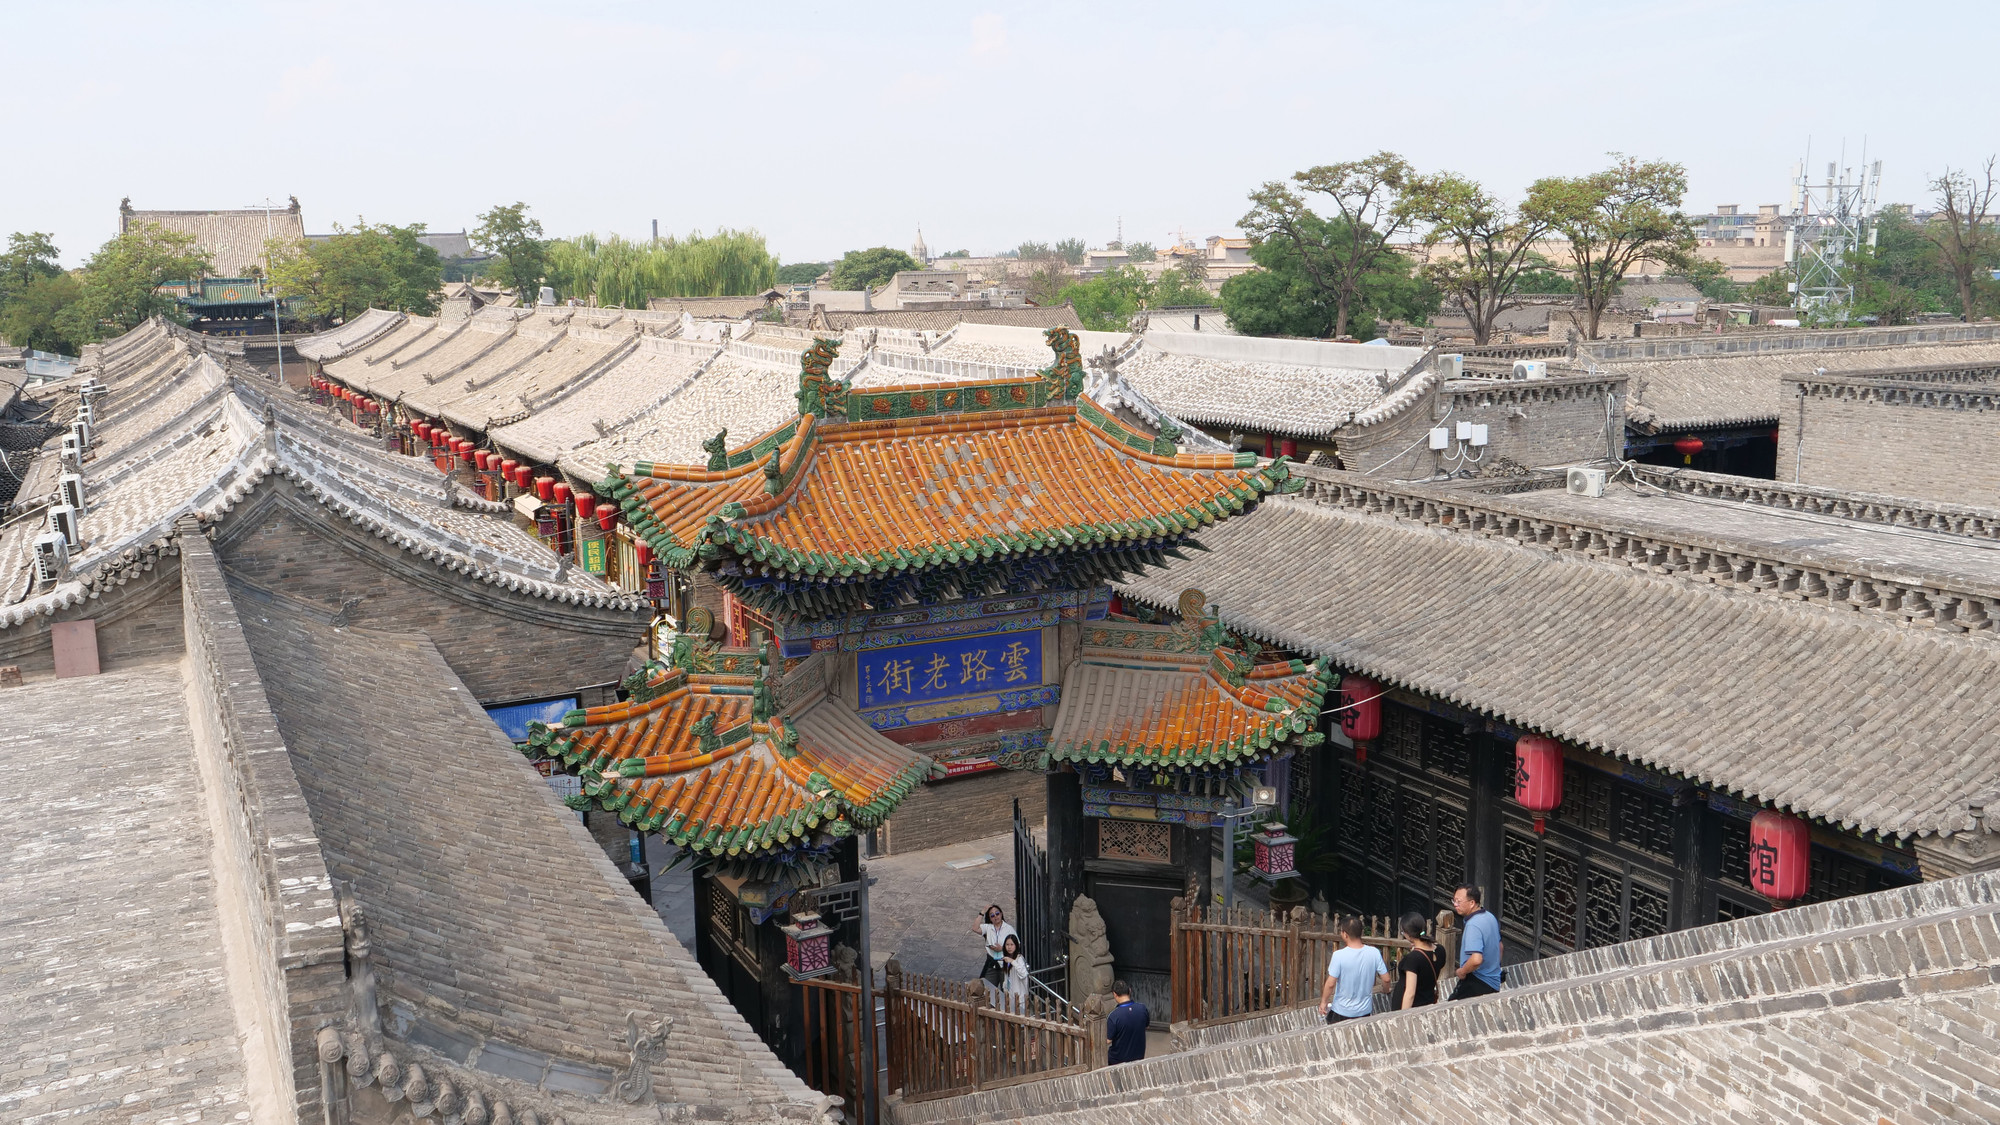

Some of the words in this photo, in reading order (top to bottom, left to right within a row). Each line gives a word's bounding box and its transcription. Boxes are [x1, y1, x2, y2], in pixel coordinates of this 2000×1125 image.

[588, 541, 600, 572] 便民超市
[878, 642, 1030, 695] 雲路老街
[1749, 835, 1778, 886] 馆
